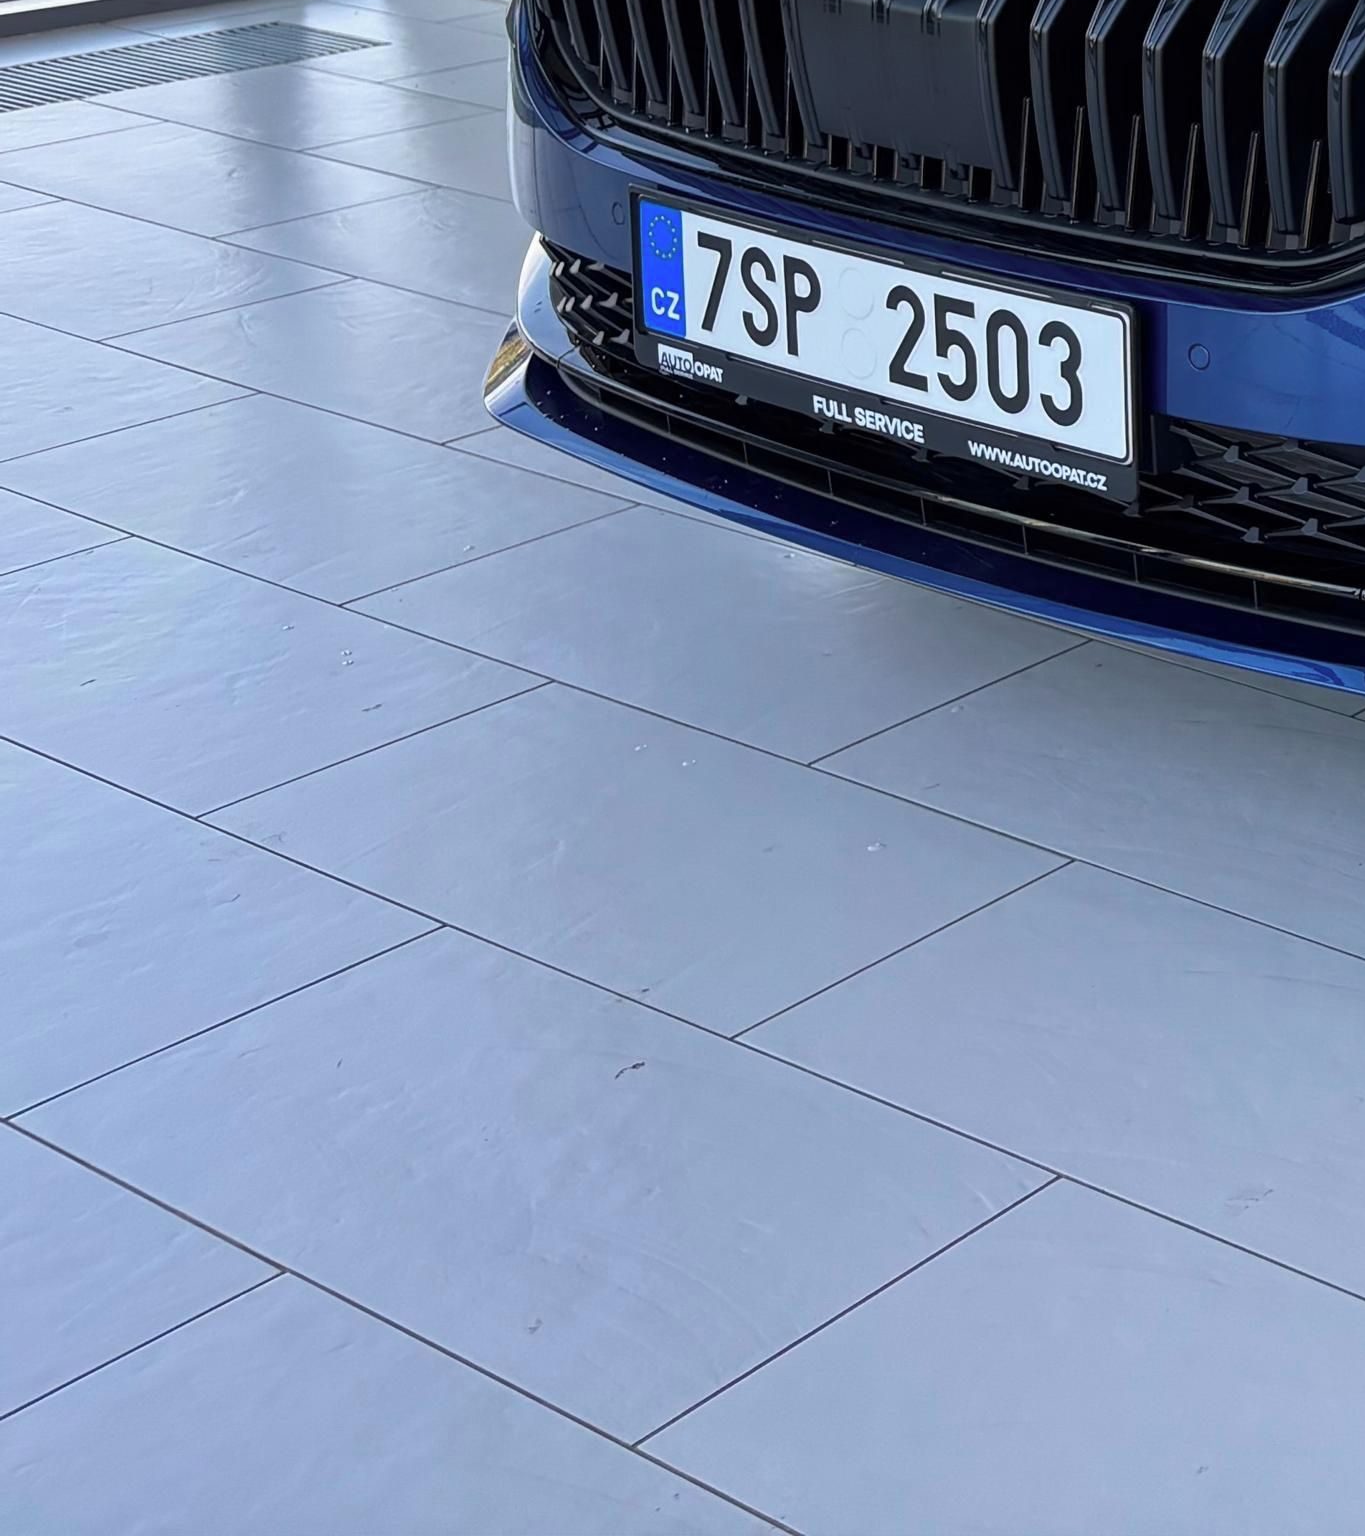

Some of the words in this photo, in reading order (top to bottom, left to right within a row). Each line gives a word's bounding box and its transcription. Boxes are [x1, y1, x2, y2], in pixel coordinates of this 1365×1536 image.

[651, 287, 681, 320] CZ
[697, 231, 822, 356] 7SP
[886, 285, 1083, 427] 2503
[812, 394, 853, 423] FULL
[854, 407, 925, 444] SERVICE
[967, 439, 1108, 491] WWW.AUTOOPAT.CZ
